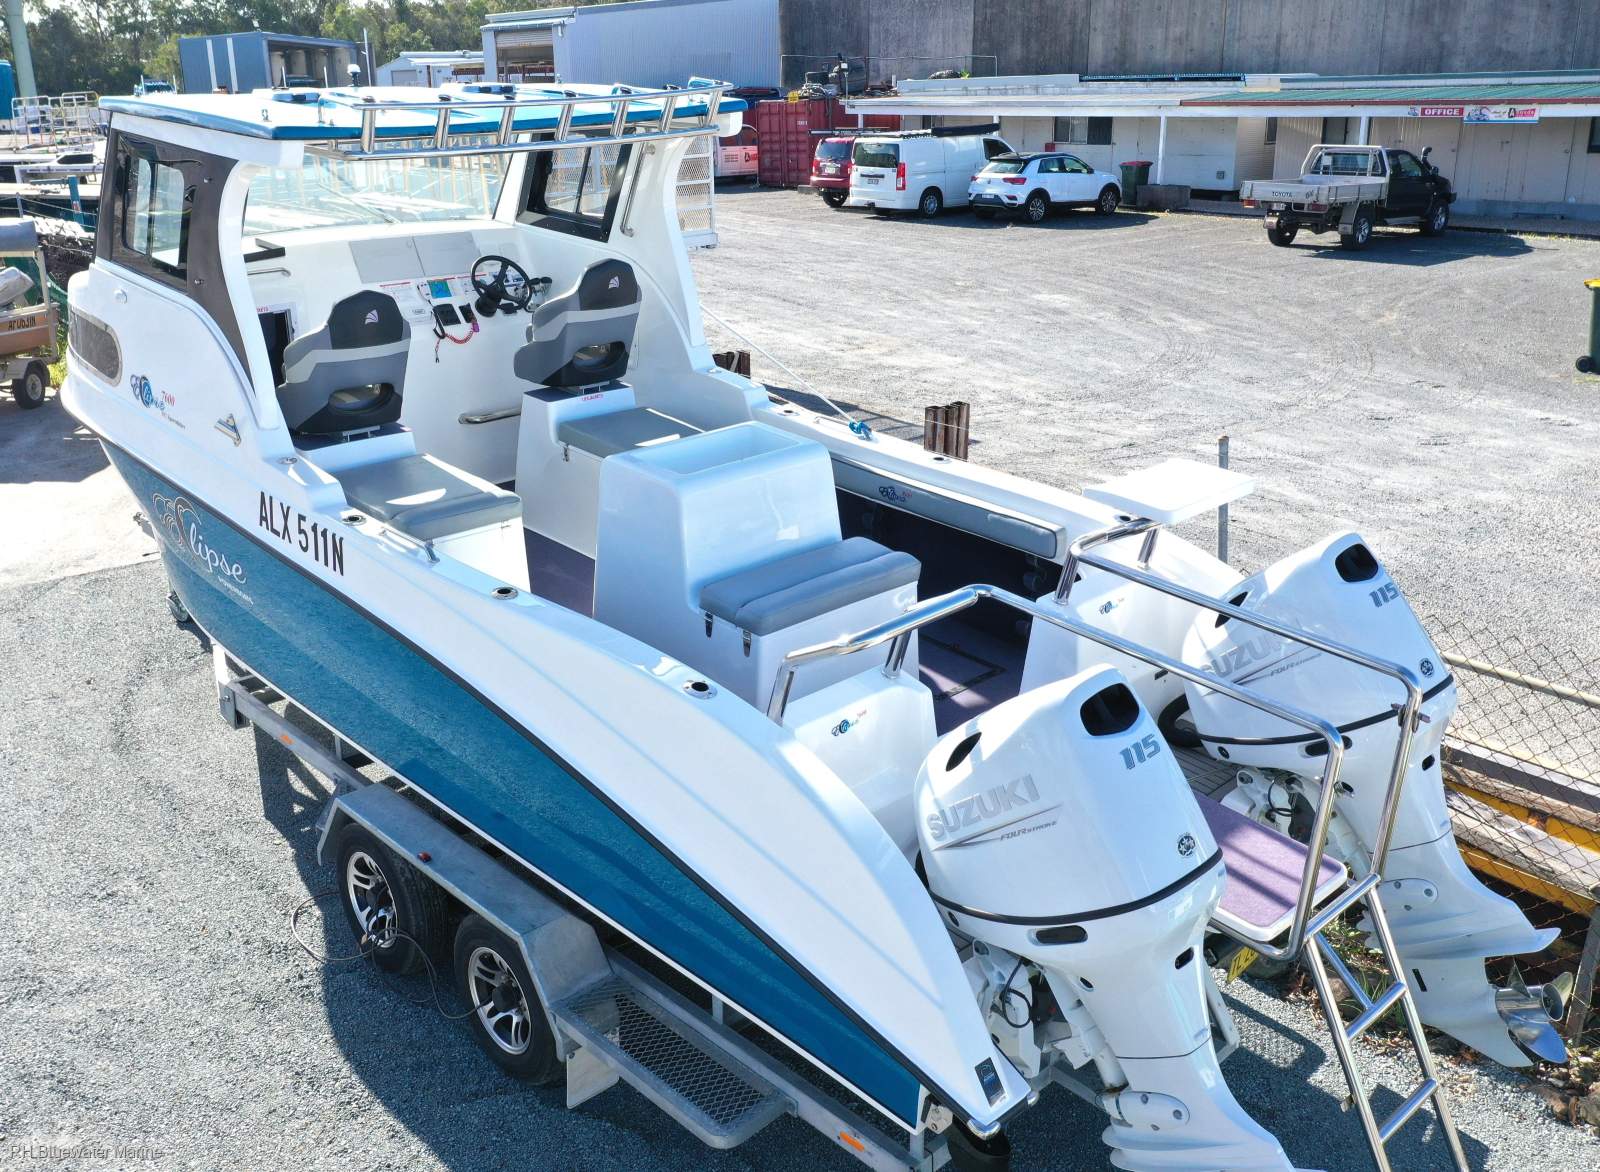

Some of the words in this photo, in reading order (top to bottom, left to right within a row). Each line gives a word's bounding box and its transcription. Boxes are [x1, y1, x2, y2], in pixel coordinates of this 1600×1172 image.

[1424, 108, 1460, 116] OFFICE
[259, 490, 292, 544] ALX
[297, 513, 344, 577] 511N
[1369, 582, 1399, 608] 115
[1119, 733, 1161, 770] 115
[926, 774, 1041, 841] SUZUKI
